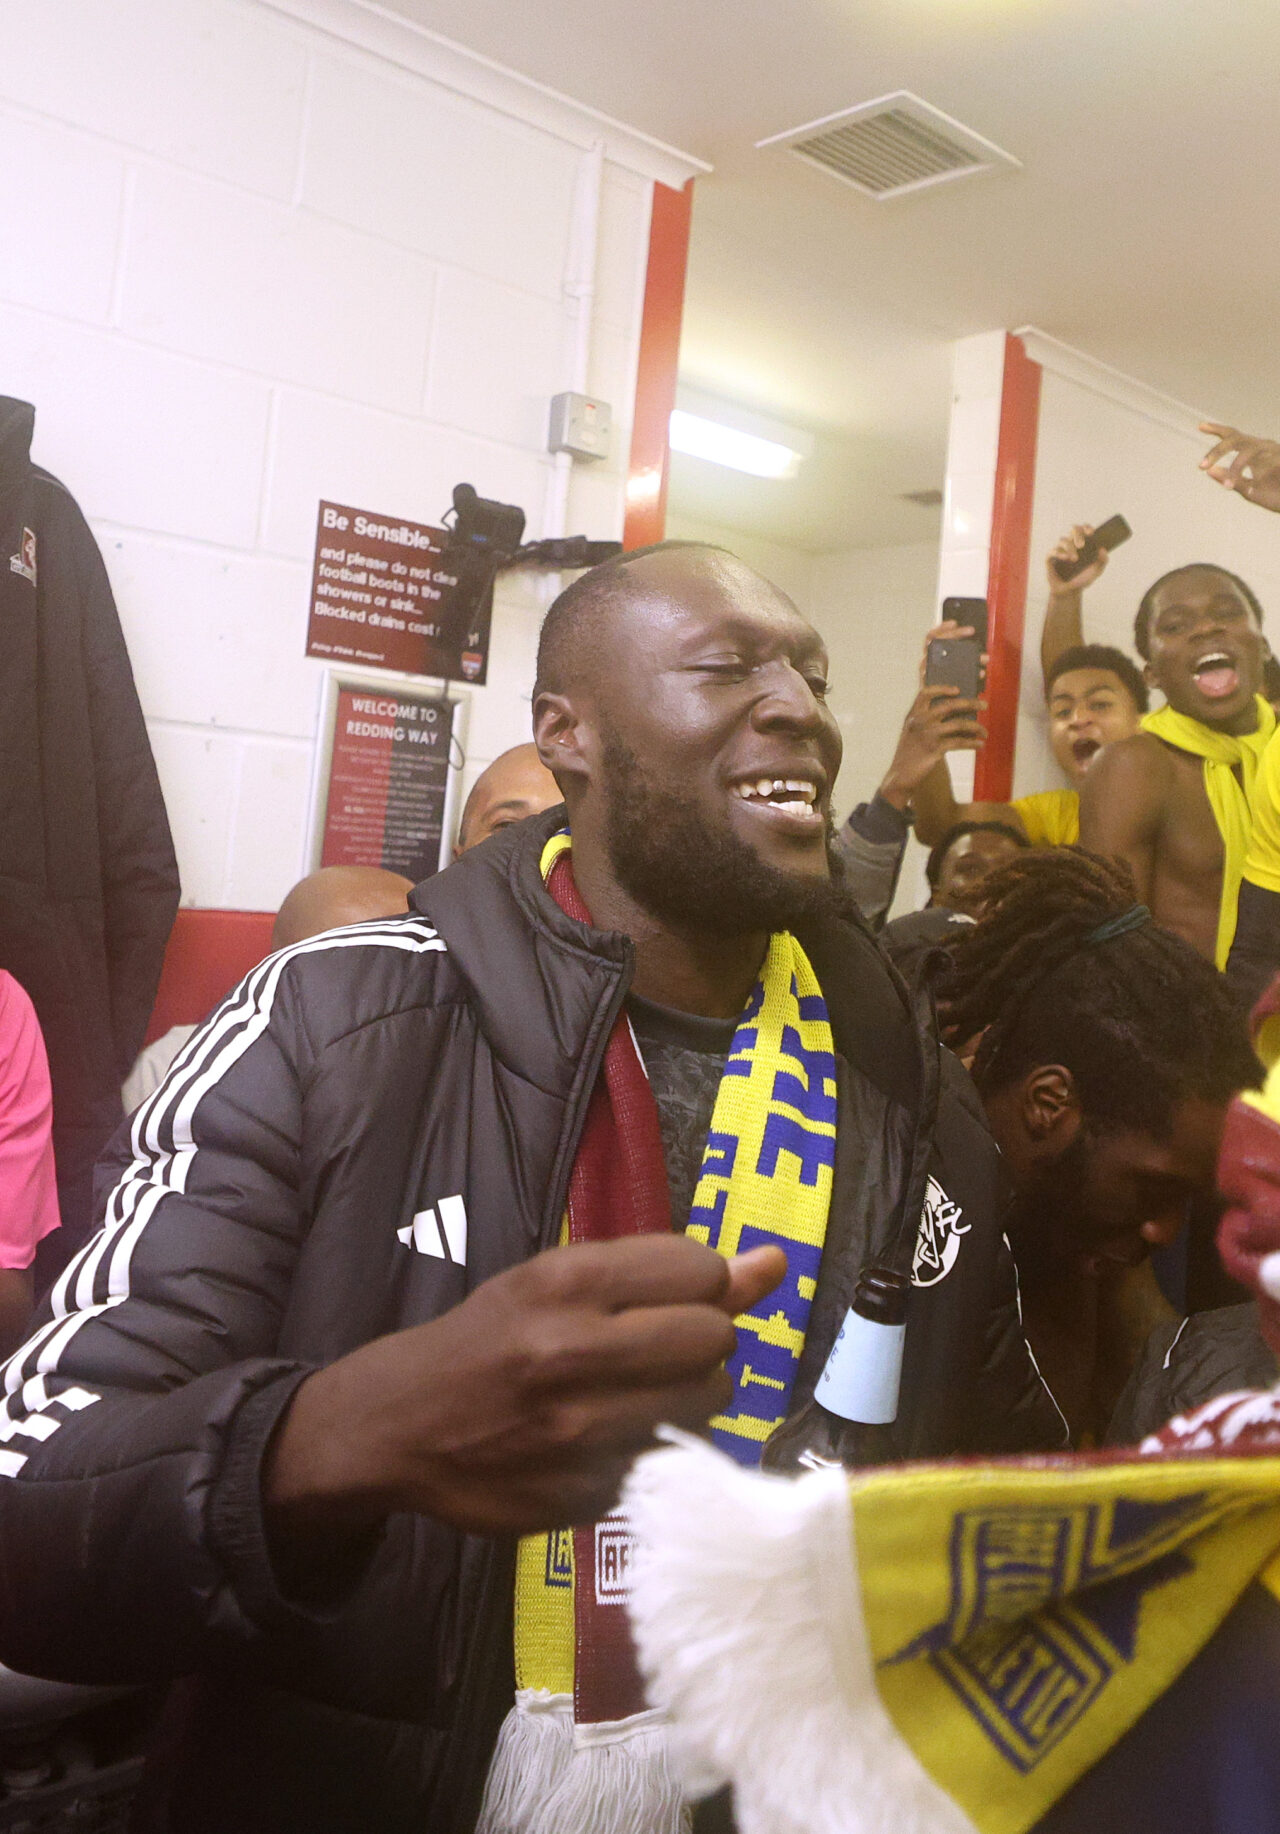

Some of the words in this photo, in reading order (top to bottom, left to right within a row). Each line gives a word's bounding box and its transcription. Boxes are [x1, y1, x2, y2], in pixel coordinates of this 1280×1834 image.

[323, 508, 349, 531] Be
[320, 547, 345, 562] and
[347, 552, 388, 571] please
[391, 562, 408, 576] do
[410, 567, 431, 581] not
[319, 563, 367, 585] football
[369, 574, 404, 593] boots
[407, 582, 419, 596] in
[421, 585, 441, 600] the
[316, 583, 372, 604] showers
[374, 594, 387, 608] or
[314, 601, 366, 623] Blocked
[368, 612, 405, 631] drains
[408, 621, 434, 636] cost
[352, 698, 417, 720] WELCOME
[420, 708, 438, 723] TO
[346, 720, 405, 741] REDDING
[408, 729, 438, 746] WAY
